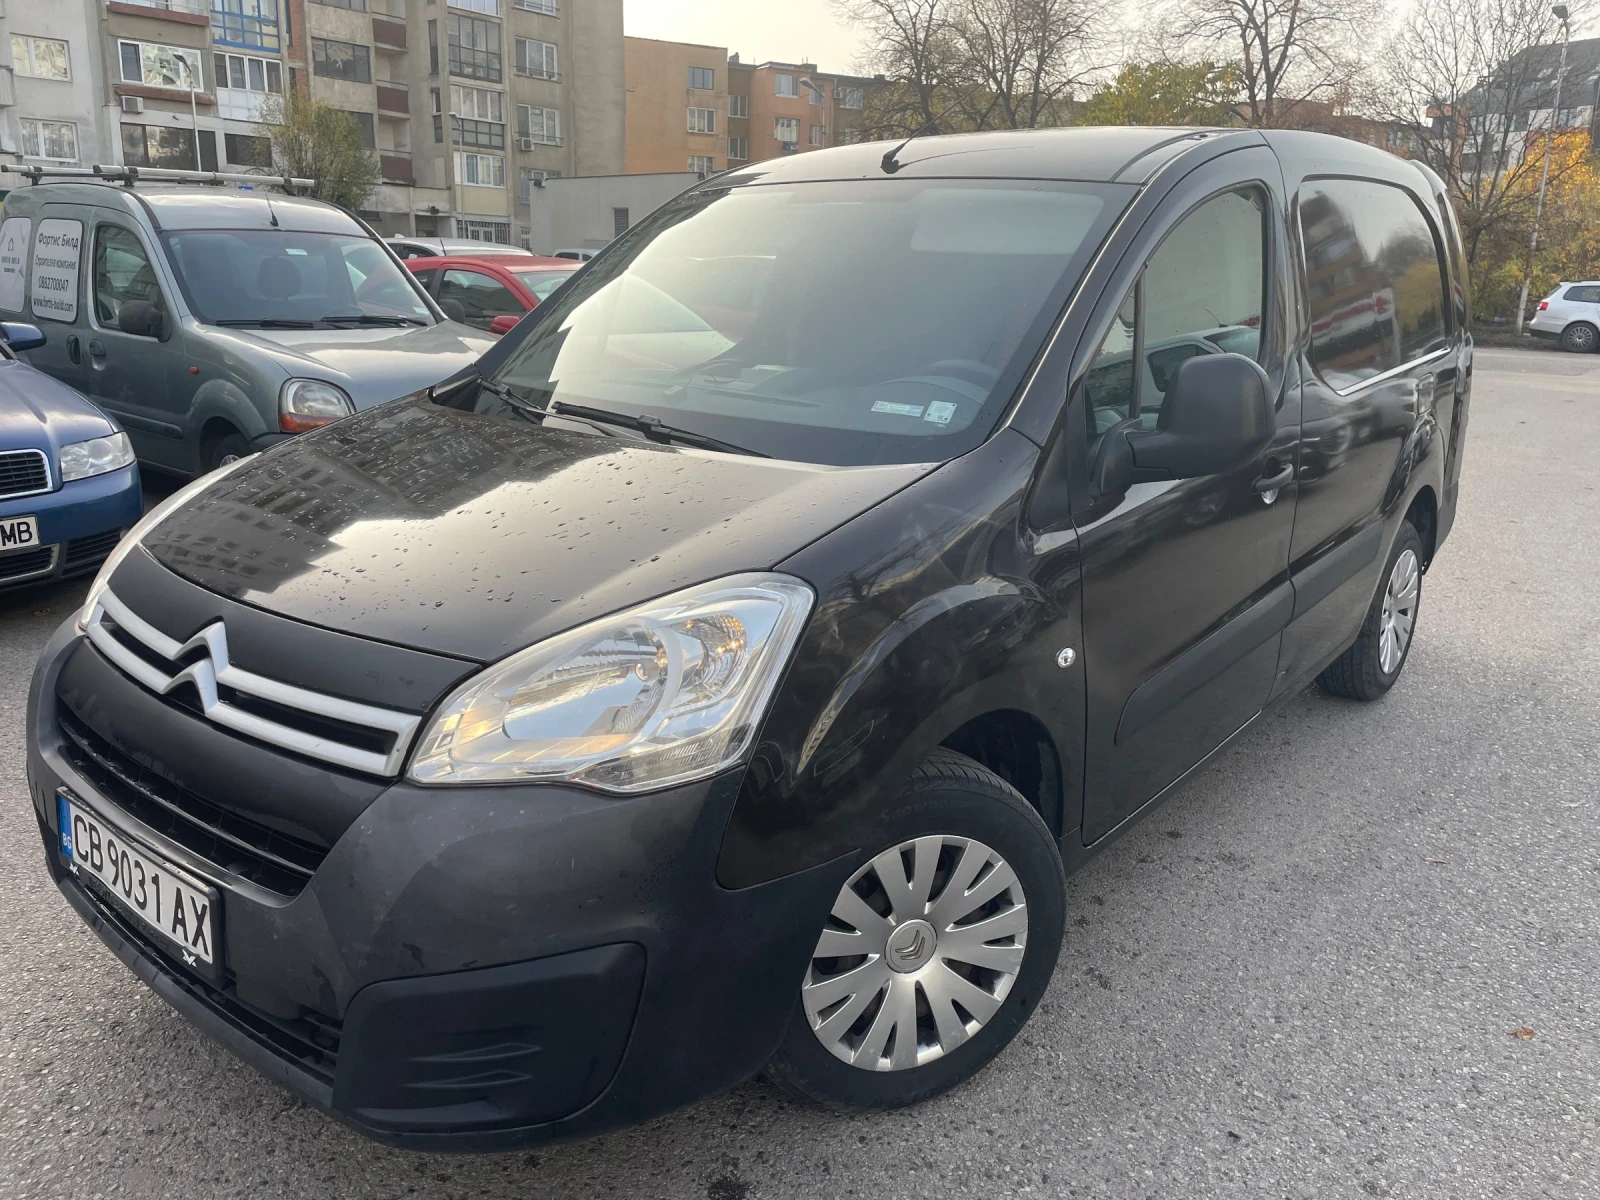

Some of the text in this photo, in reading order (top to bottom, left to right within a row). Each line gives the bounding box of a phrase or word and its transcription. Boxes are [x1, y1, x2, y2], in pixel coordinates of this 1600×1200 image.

[38, 232, 79, 251] Фортис Билд
[0, 521, 33, 546] MB
[62, 832, 73, 850] BG
